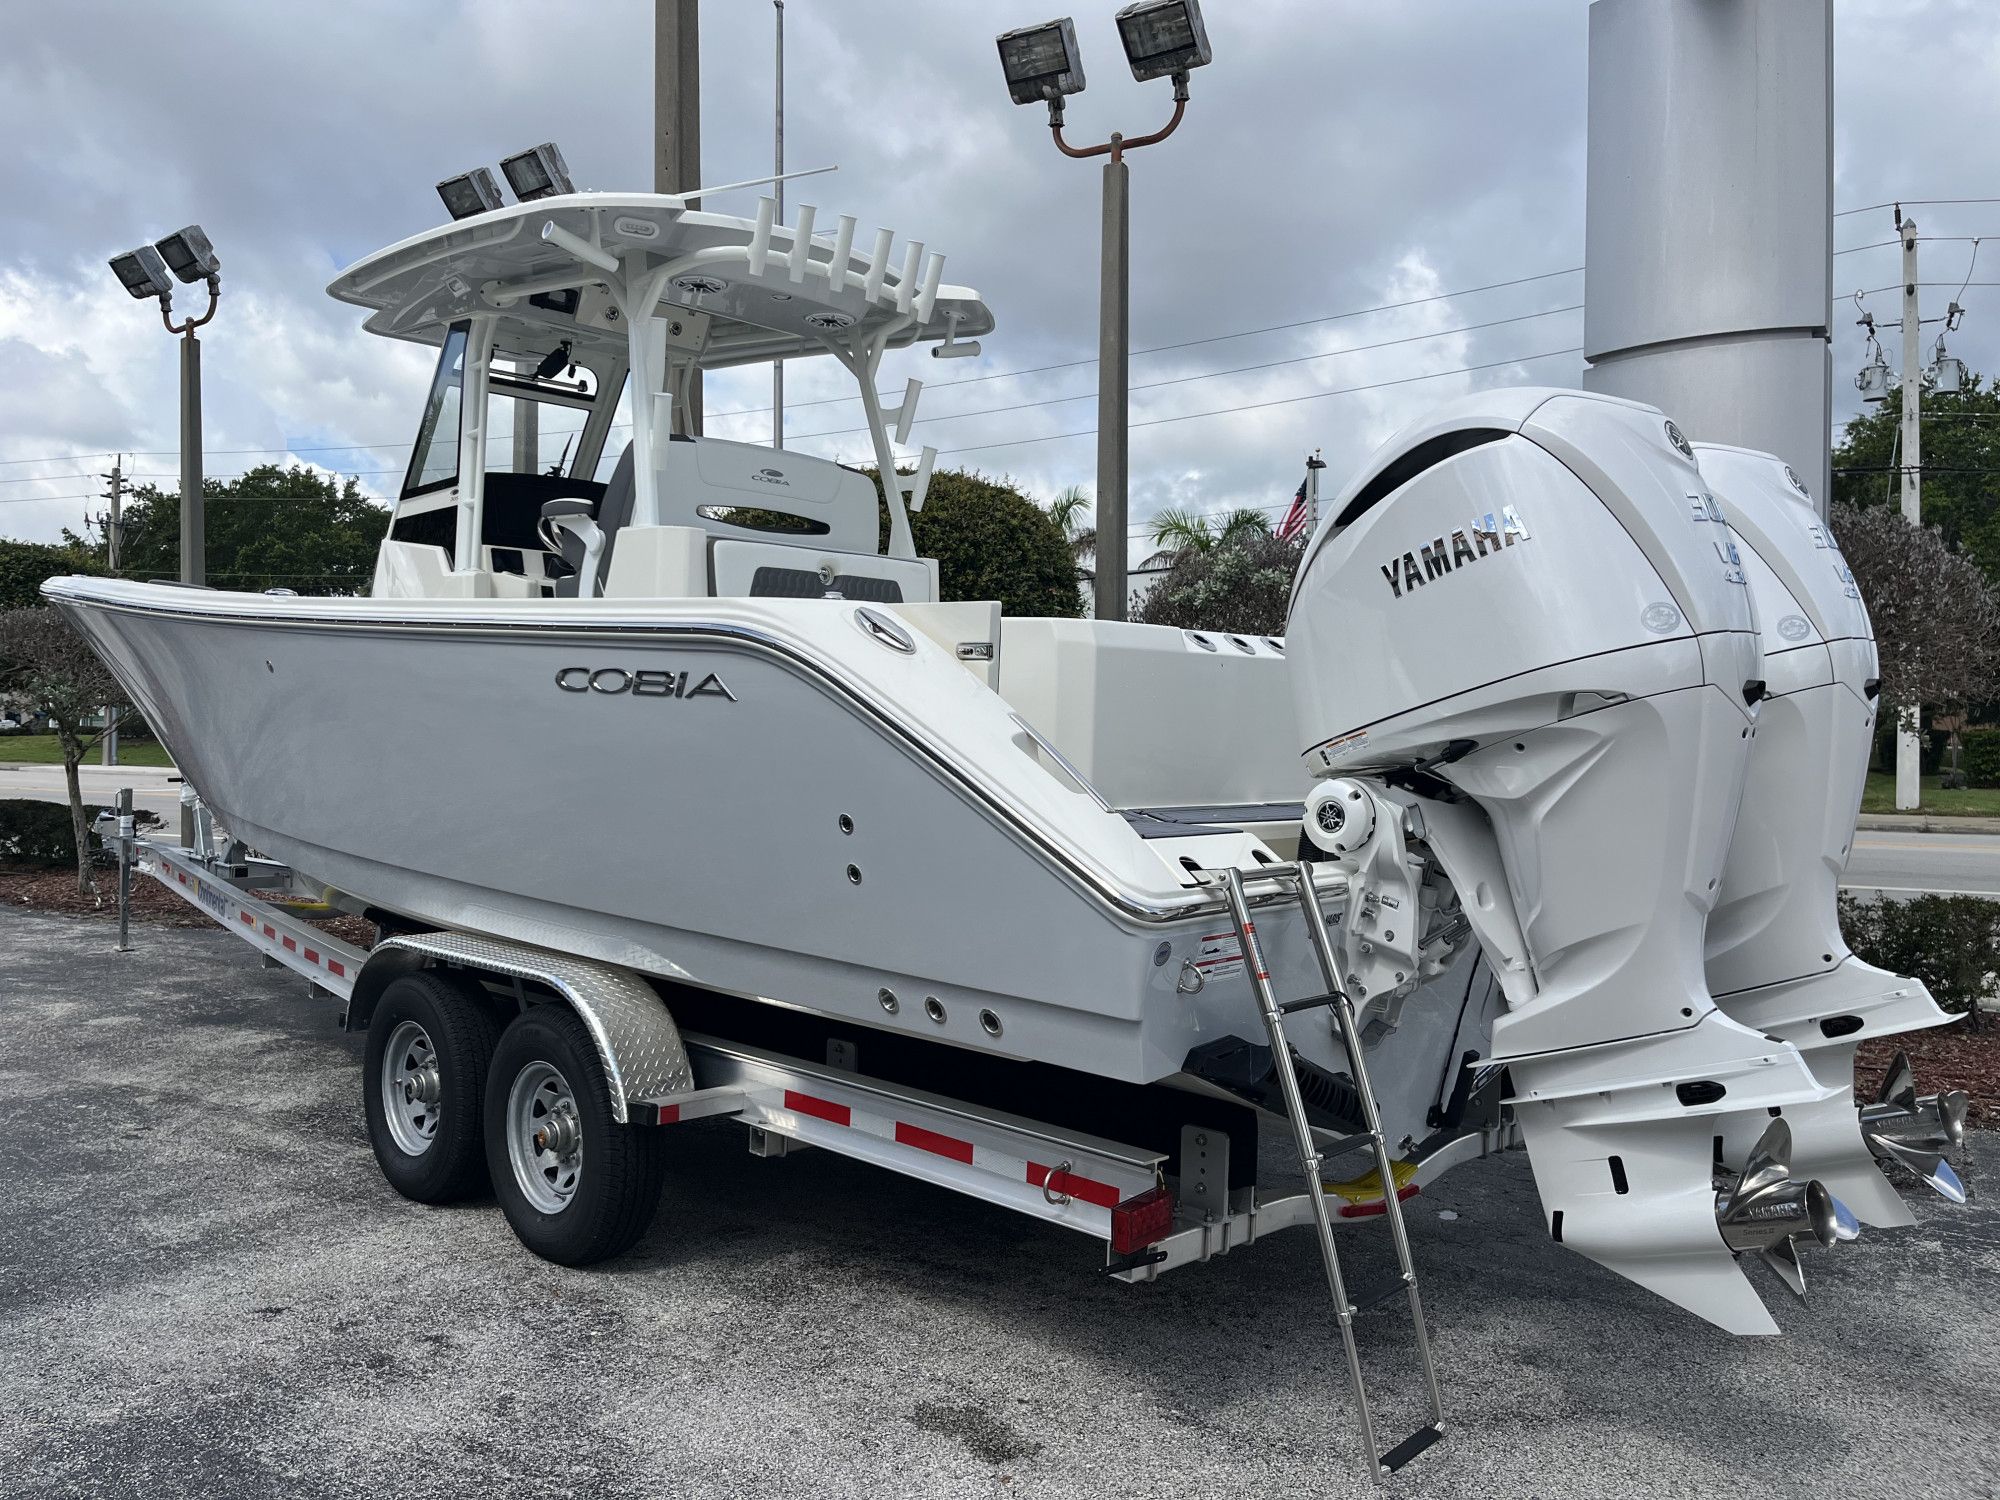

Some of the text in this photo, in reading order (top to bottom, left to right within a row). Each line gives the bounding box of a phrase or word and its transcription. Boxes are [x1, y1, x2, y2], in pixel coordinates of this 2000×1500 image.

[751, 475, 791, 487] COBIA
[1380, 503, 1532, 599] YAMAHA
[555, 667, 739, 702] COBIA
[198, 879, 227, 918] Continental
[1749, 1203, 1801, 1219] YAMAHA
[1743, 1229, 1768, 1237] Series
